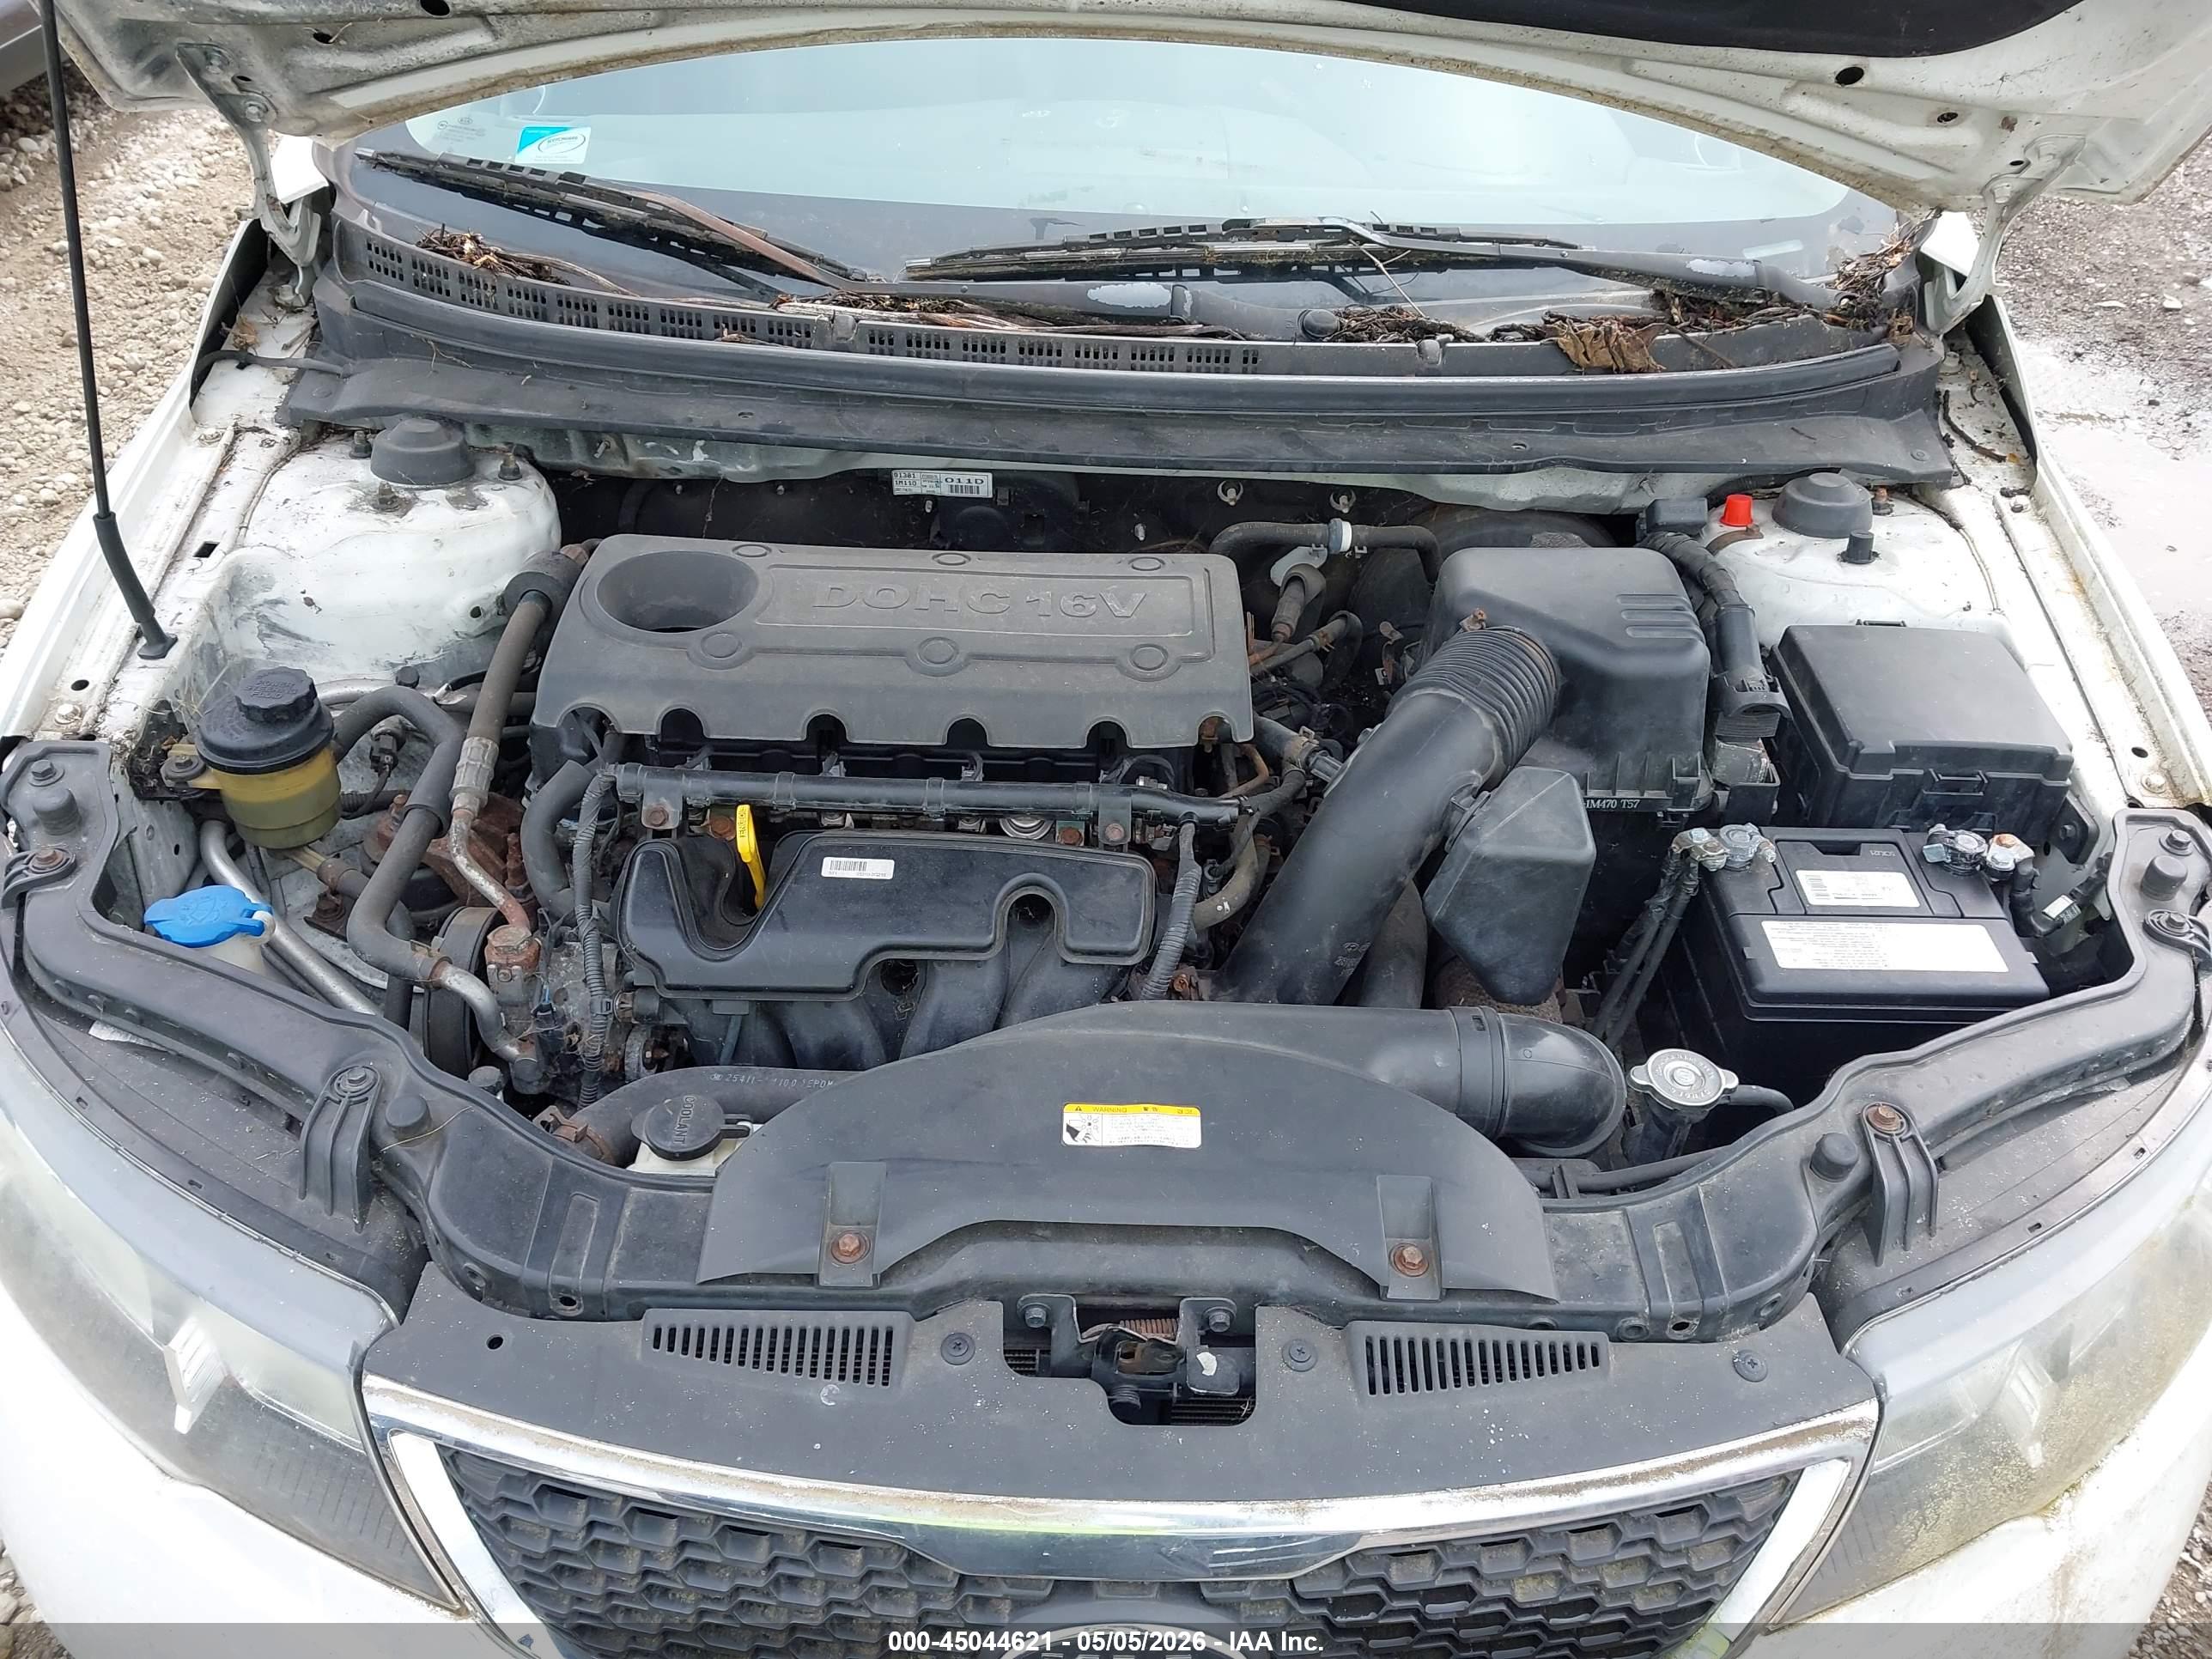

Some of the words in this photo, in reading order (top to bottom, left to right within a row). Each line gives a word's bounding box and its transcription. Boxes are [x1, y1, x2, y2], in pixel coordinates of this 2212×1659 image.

[811, 586, 1011, 614] DOHC
[1025, 591, 1147, 618] 16V
[1620, 799, 1641, 809] T57
[672, 1096, 696, 1145] COOLANT
